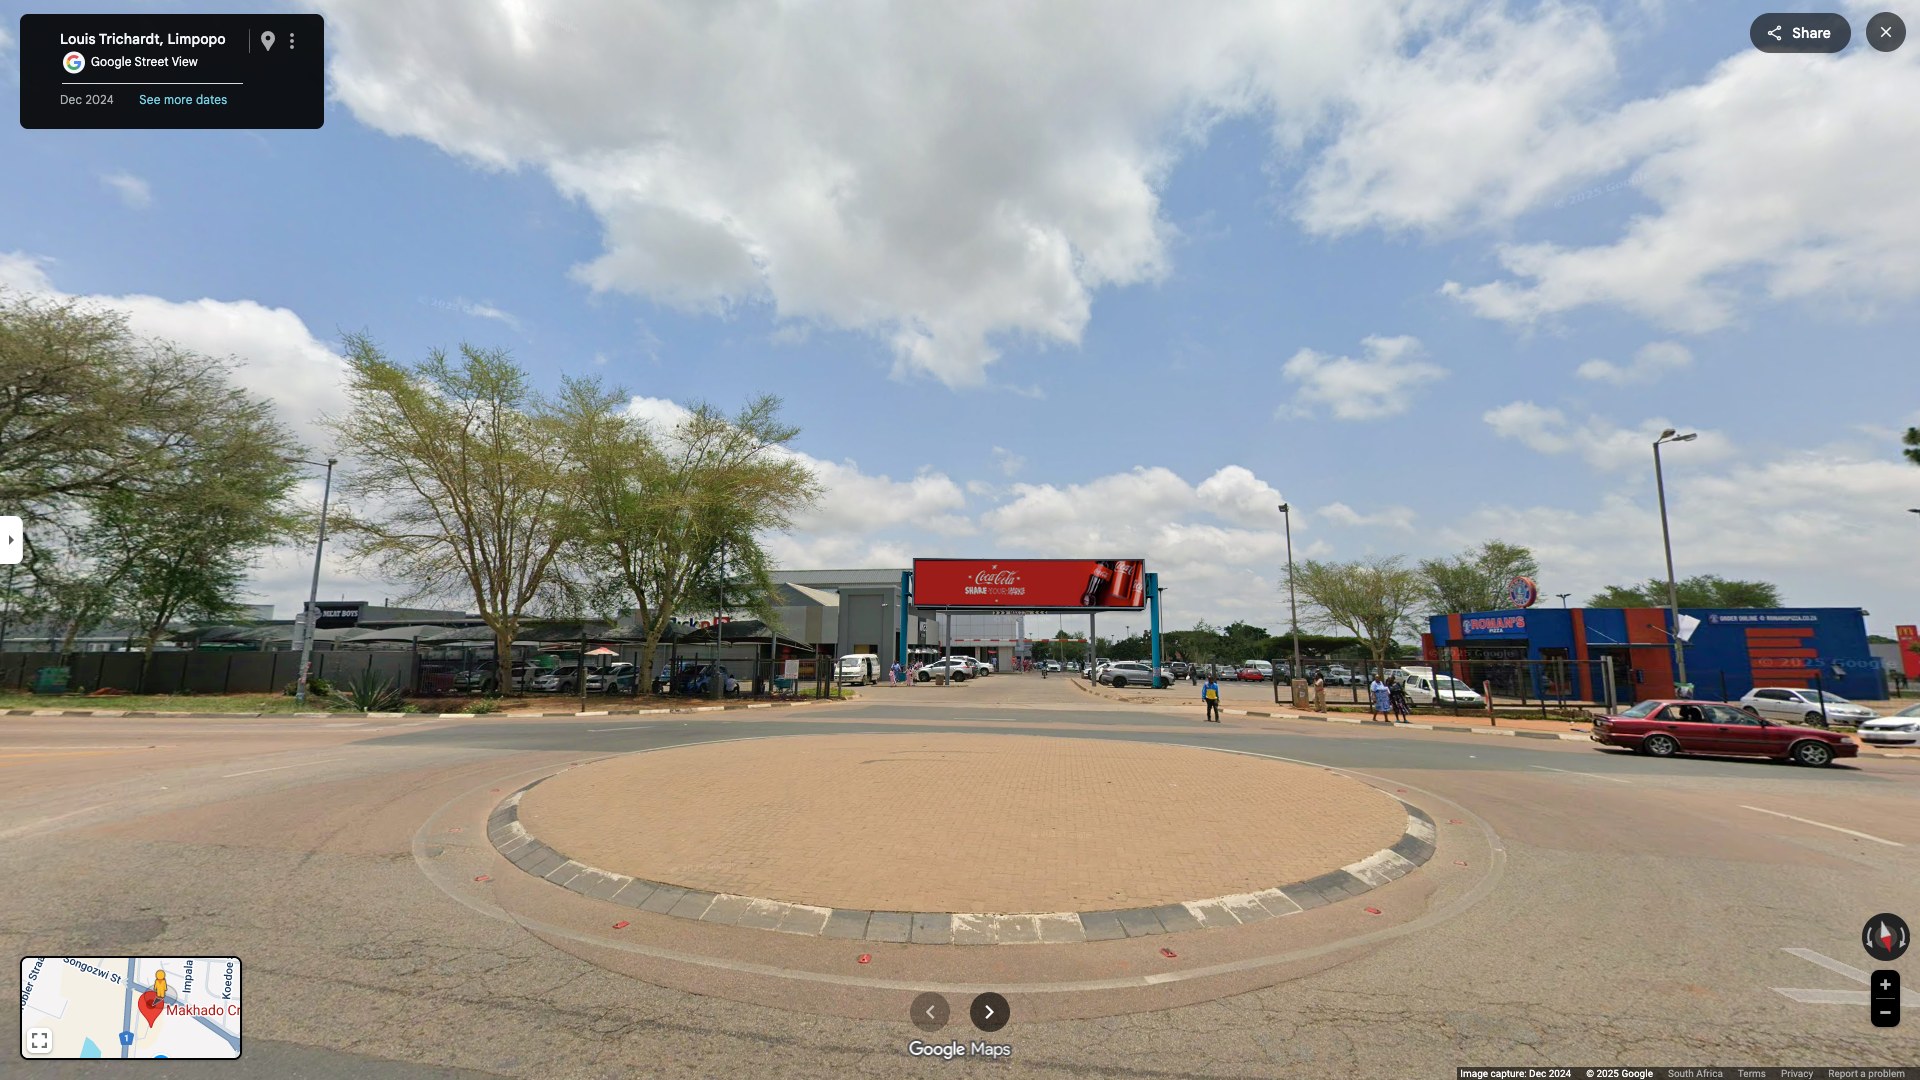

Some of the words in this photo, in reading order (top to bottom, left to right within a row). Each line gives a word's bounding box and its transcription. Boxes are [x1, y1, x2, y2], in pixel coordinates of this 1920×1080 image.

[965, 587, 987, 595] SHARE
[322, 610, 341, 618] MEAT
[1471, 616, 1526, 630] ROMAN'S
